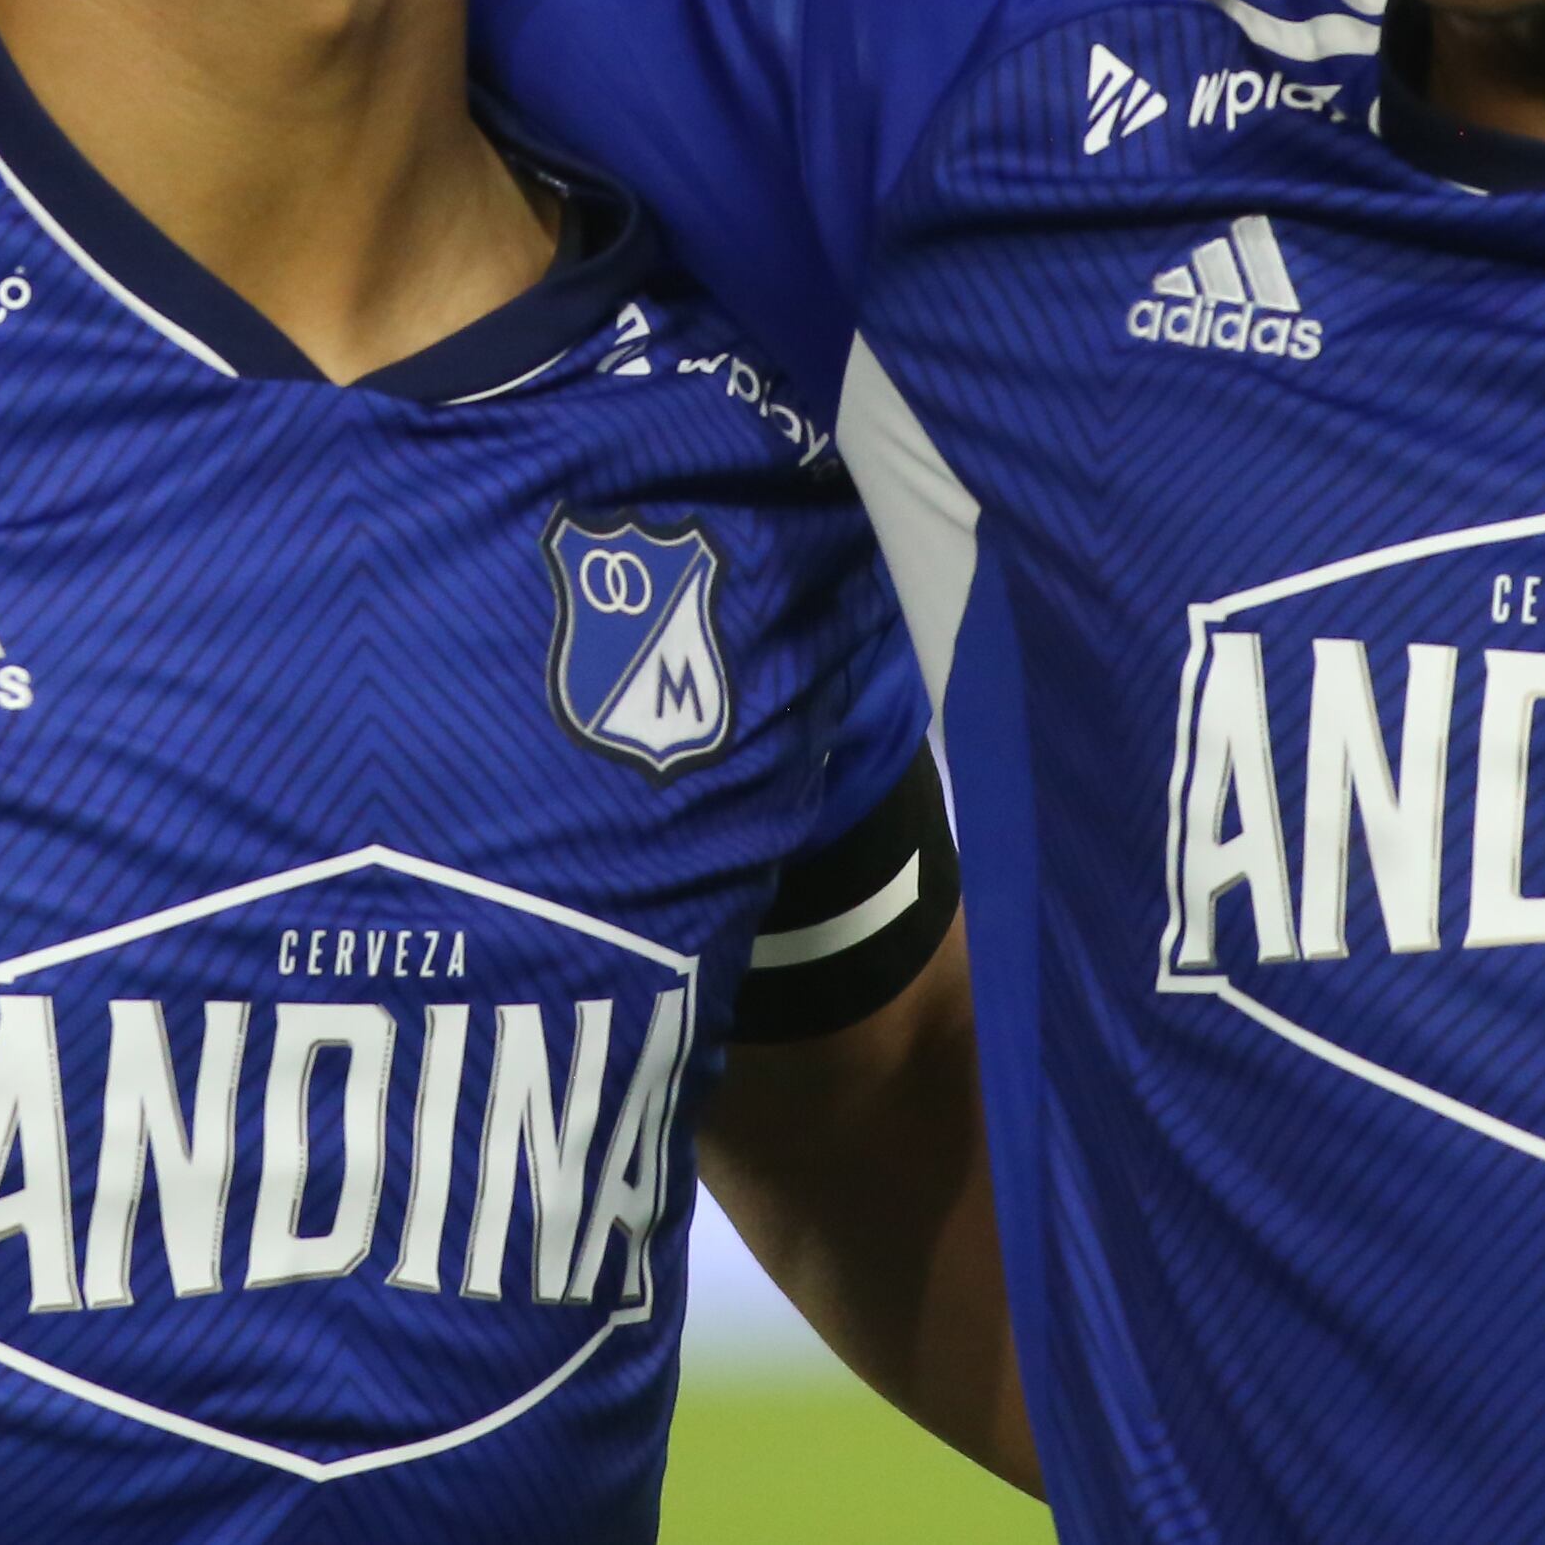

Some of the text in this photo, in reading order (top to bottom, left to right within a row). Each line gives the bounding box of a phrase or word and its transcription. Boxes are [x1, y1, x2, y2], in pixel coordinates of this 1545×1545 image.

[1126, 295, 1323, 360] adidas
[655, 654, 704, 723] M
[278, 929, 466, 977] CERVEZA
